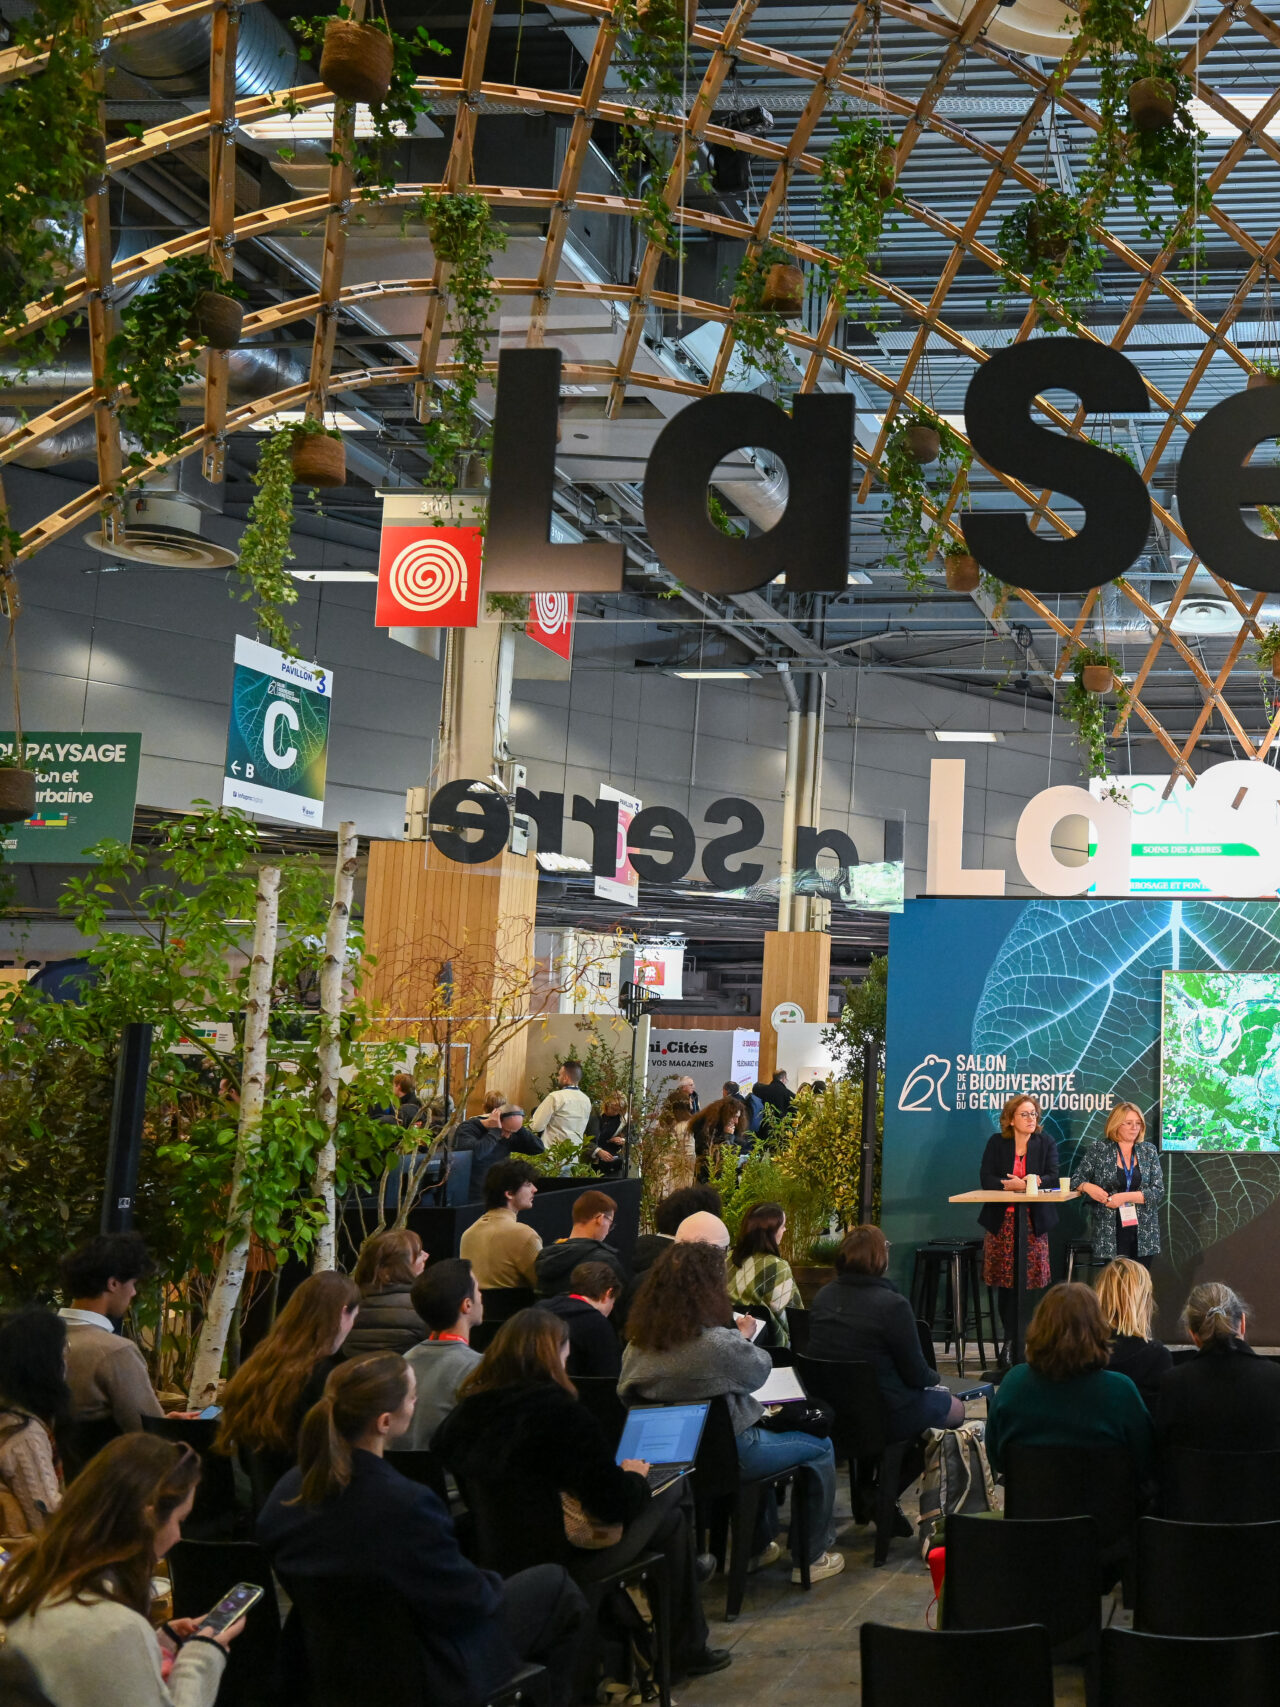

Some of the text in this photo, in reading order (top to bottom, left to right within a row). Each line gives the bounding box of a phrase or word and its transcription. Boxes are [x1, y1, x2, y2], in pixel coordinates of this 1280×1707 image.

[486, 348, 854, 593] La
[282, 663, 313, 682] PAVILLON
[317, 670, 326, 693] 3
[263, 701, 300, 769] C
[25, 743, 127, 763] PAYSAGE
[62, 769, 79, 783] et
[246, 763, 254, 778] B
[930, 758, 1131, 897] La
[1171, 846, 1187, 854] DES
[1189, 846, 1222, 854] ARBRES
[1172, 881, 1183, 889] ET
[669, 1060, 714, 1068] MAGAZINES
[956, 1054, 1006, 1072] SALON
[957, 1074, 966, 1082] DE
[957, 1082, 967, 1090] LA
[957, 1093, 966, 1101] ET
[1027, 1091, 1115, 1112] COLOGIQUE
[957, 1101, 966, 1110] DU
